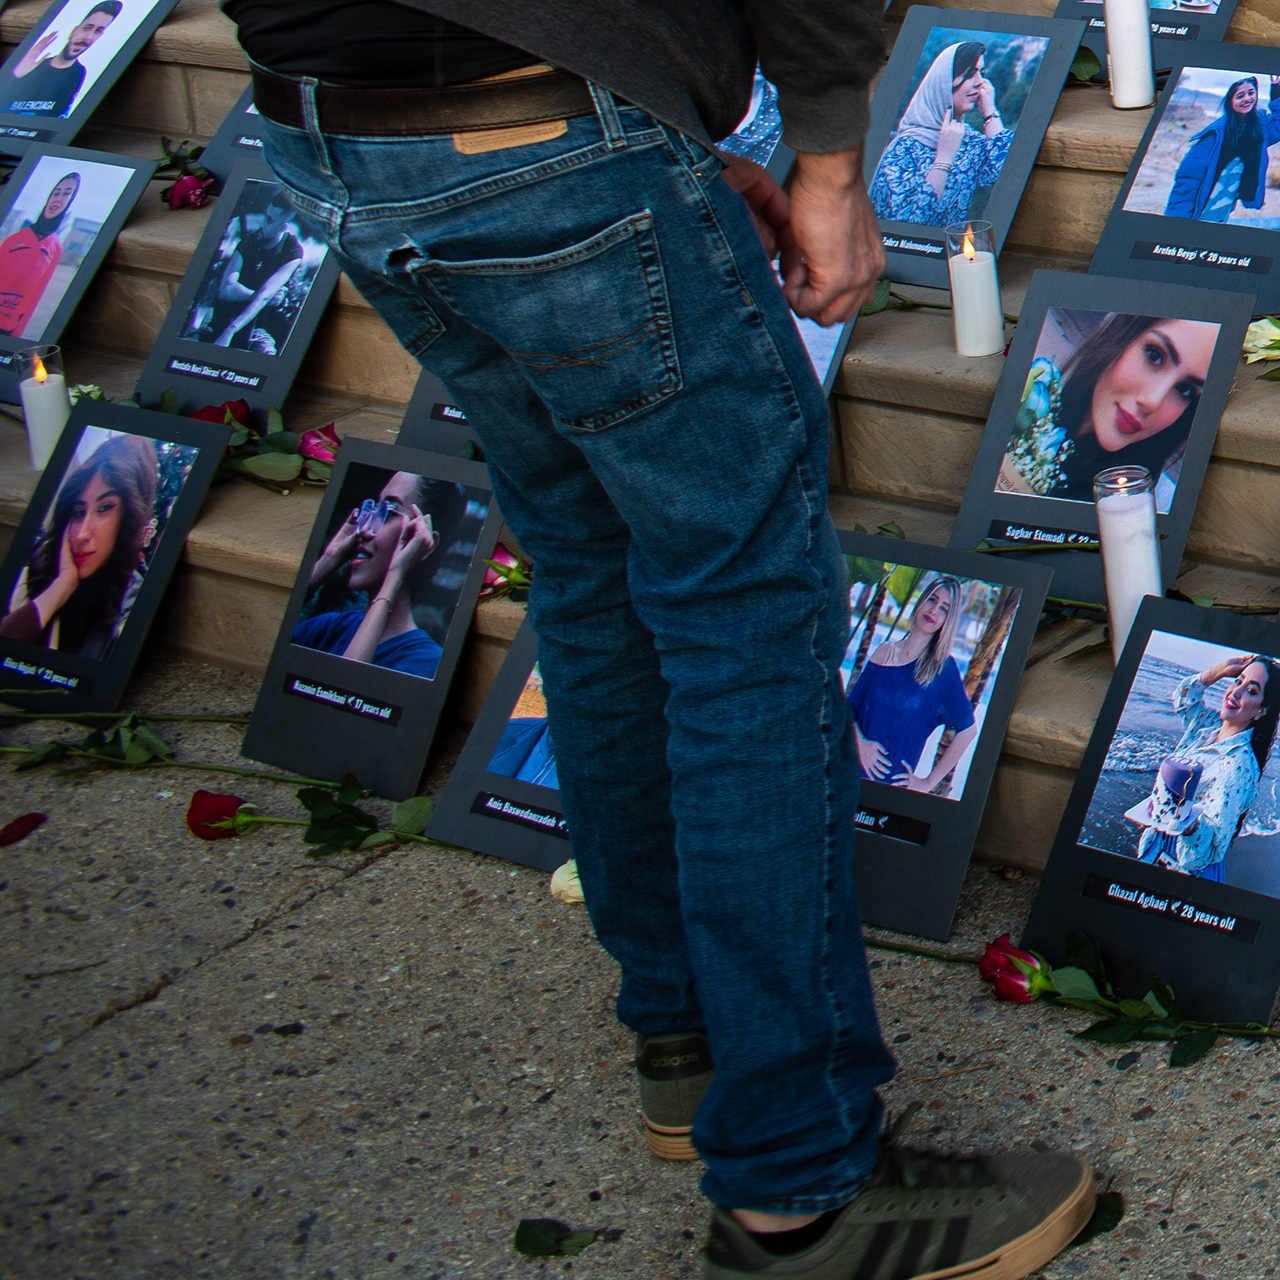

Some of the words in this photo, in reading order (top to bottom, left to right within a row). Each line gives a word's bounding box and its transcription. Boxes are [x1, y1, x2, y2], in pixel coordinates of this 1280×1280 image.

[1207, 253, 1219, 262] 20
[1217, 255, 1237, 264] years
[1237, 257, 1251, 267] old
[1005, 526, 1033, 539] Saghar
[1033, 530, 1066, 543] Etemadi
[293, 680, 316, 695] Nazanin
[354, 698, 363, 709] 17
[360, 703, 380, 715] years
[379, 707, 392, 719] old
[486, 797, 503, 810] Anis
[1108, 883, 1139, 902] Ghazal
[1137, 890, 1169, 911] Aghaei
[1180, 904, 1195, 918] 28
[1193, 910, 1219, 926] years
[1219, 916, 1236, 931] old
